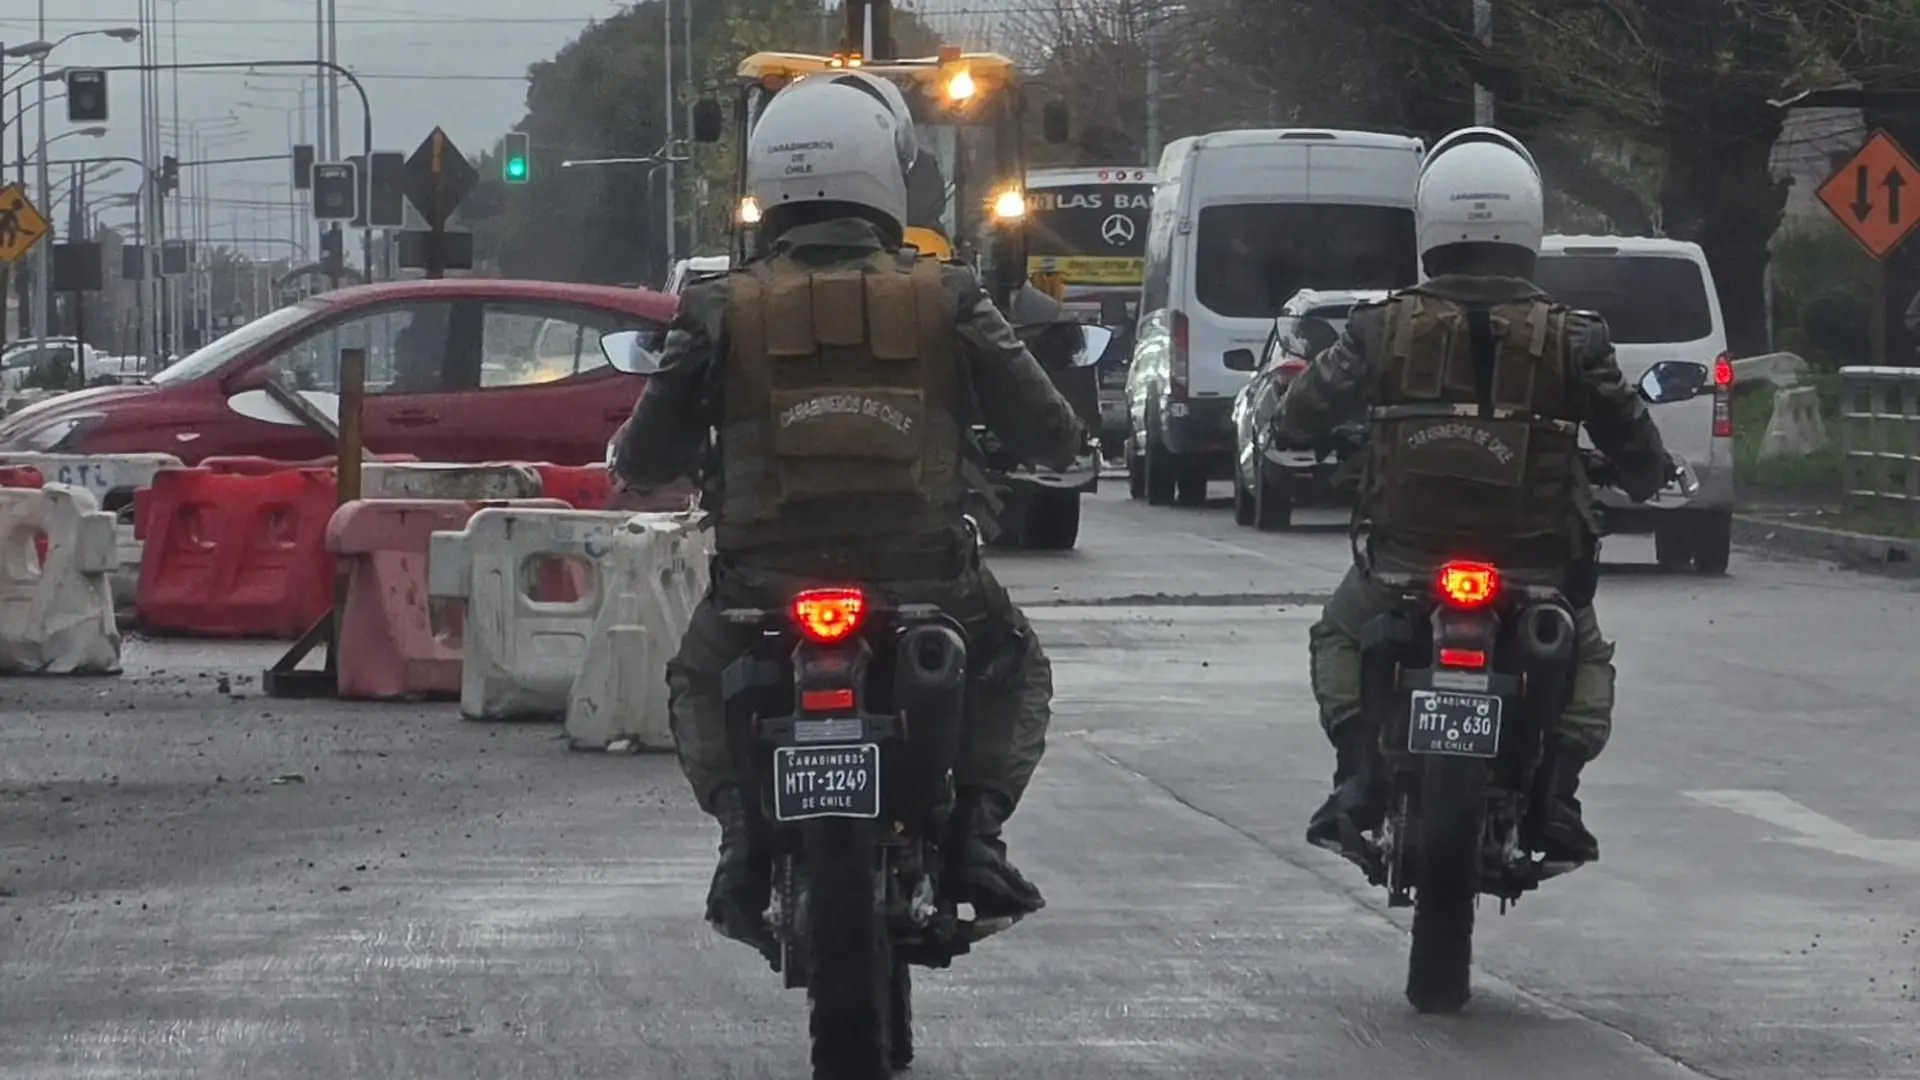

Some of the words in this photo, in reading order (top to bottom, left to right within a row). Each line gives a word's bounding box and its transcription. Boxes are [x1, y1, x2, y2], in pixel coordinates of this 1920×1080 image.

[791, 153, 804, 162] DE
[784, 164, 813, 174] CHILE
[1057, 194, 1102, 208] LAS
[781, 395, 860, 428] CARABINEROS
[788, 754, 865, 767] CARABINEROS
[802, 798, 815, 809] DE
[820, 796, 852, 807] CHILE
